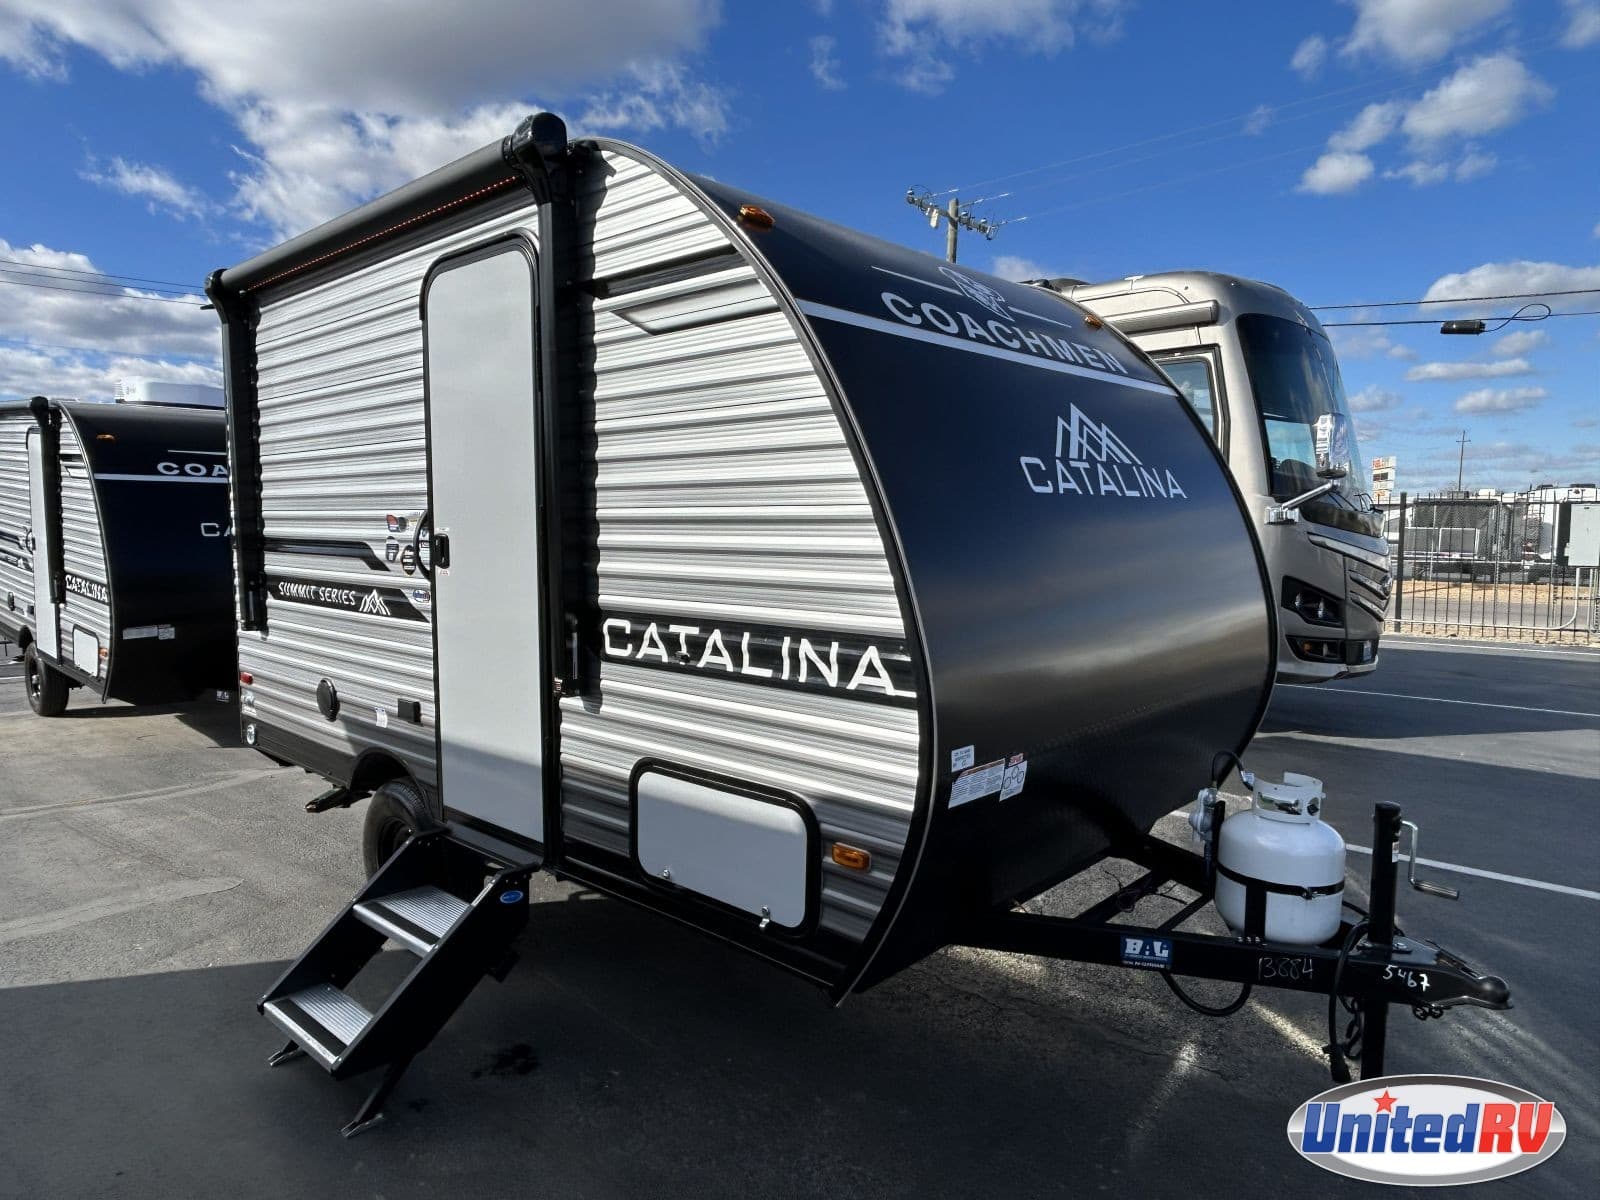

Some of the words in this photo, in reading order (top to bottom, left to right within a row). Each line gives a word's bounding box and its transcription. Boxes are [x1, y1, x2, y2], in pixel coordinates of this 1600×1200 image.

[880, 291, 1130, 375] COACHMEN
[1019, 455, 1189, 500] CATALINA
[65, 573, 109, 603] CATALINA
[278, 581, 317, 600] SUMMIT
[318, 587, 357, 606] SERIES
[602, 617, 917, 699] CATALINA
[1382, 964, 1431, 992] 5467
